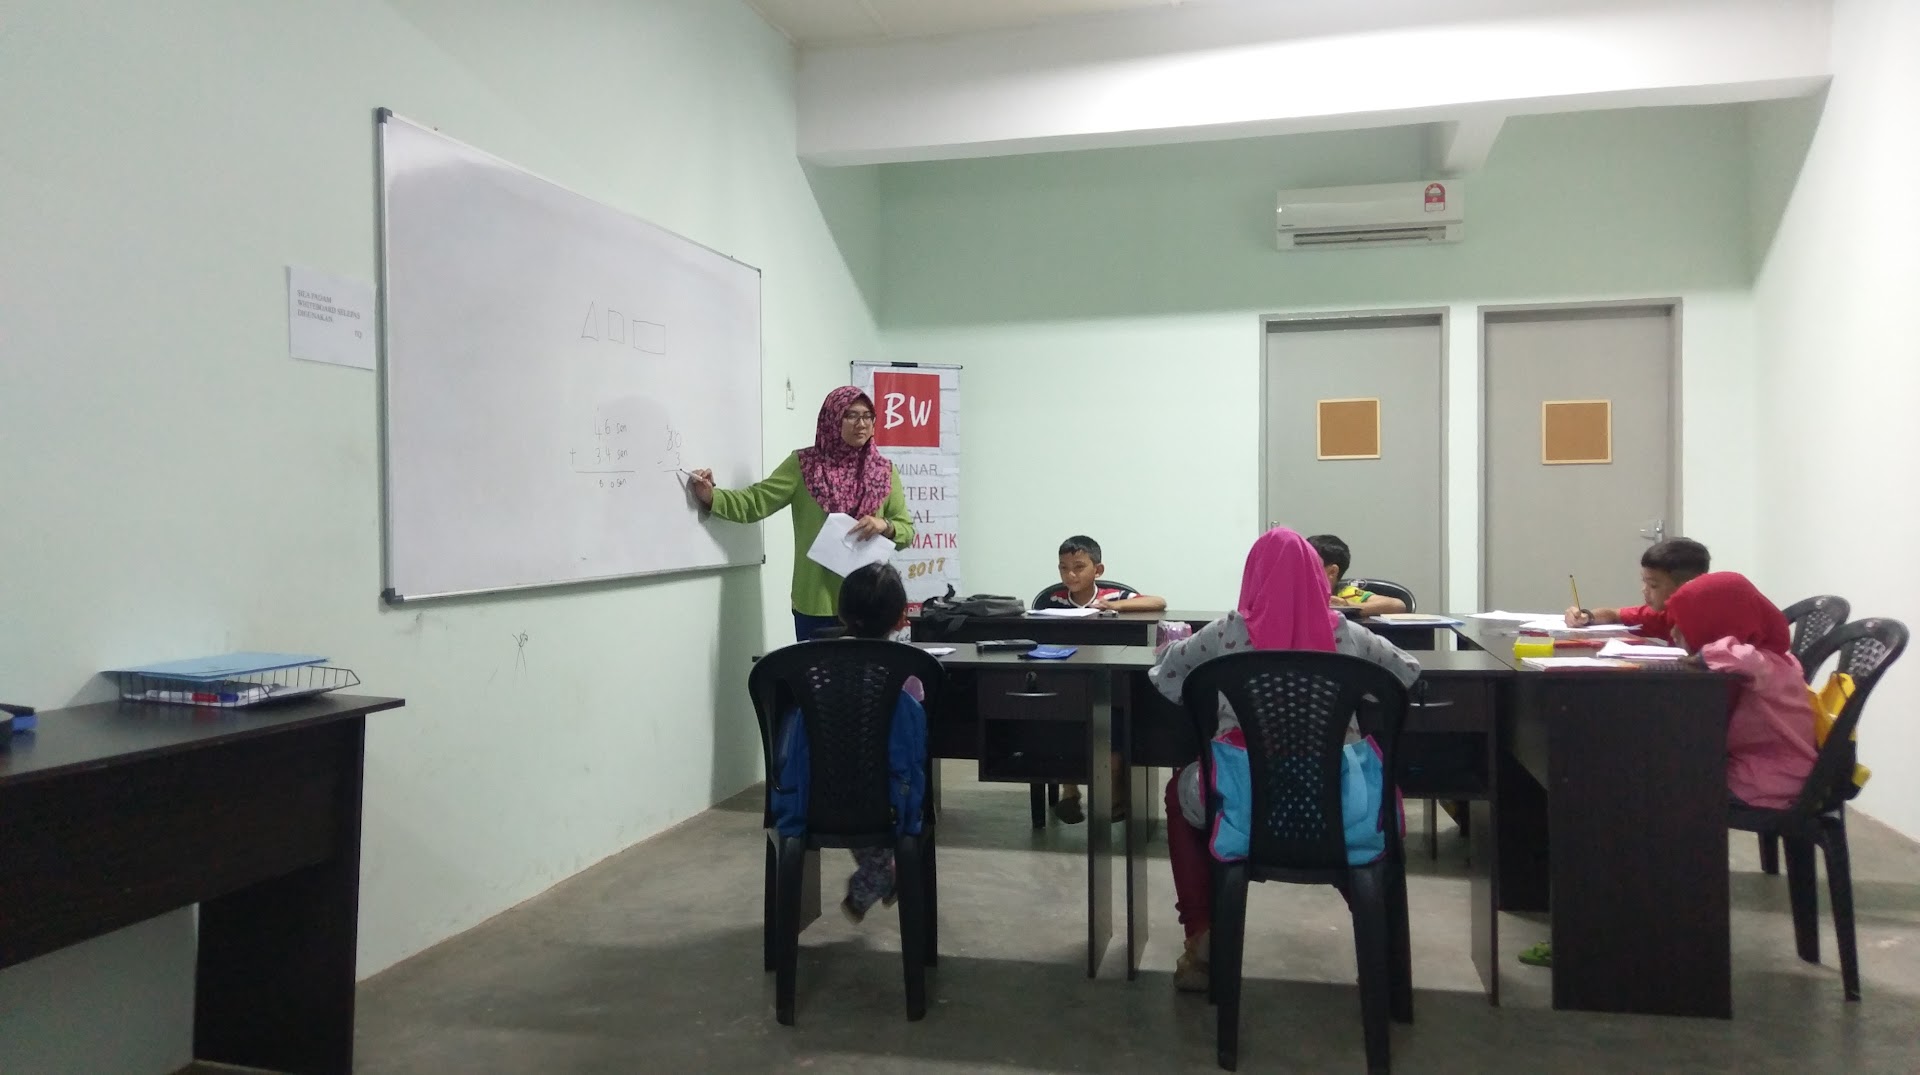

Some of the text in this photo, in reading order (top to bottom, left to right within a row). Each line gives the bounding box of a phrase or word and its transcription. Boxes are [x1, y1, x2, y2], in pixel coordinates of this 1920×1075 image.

[298, 300, 336, 314] WHITEBOARD
[884, 392, 932, 430] BW
[894, 463, 938, 476] MINAR
[902, 486, 945, 501] TERI
[909, 532, 957, 549] MATIK
[908, 557, 946, 579] 2017
